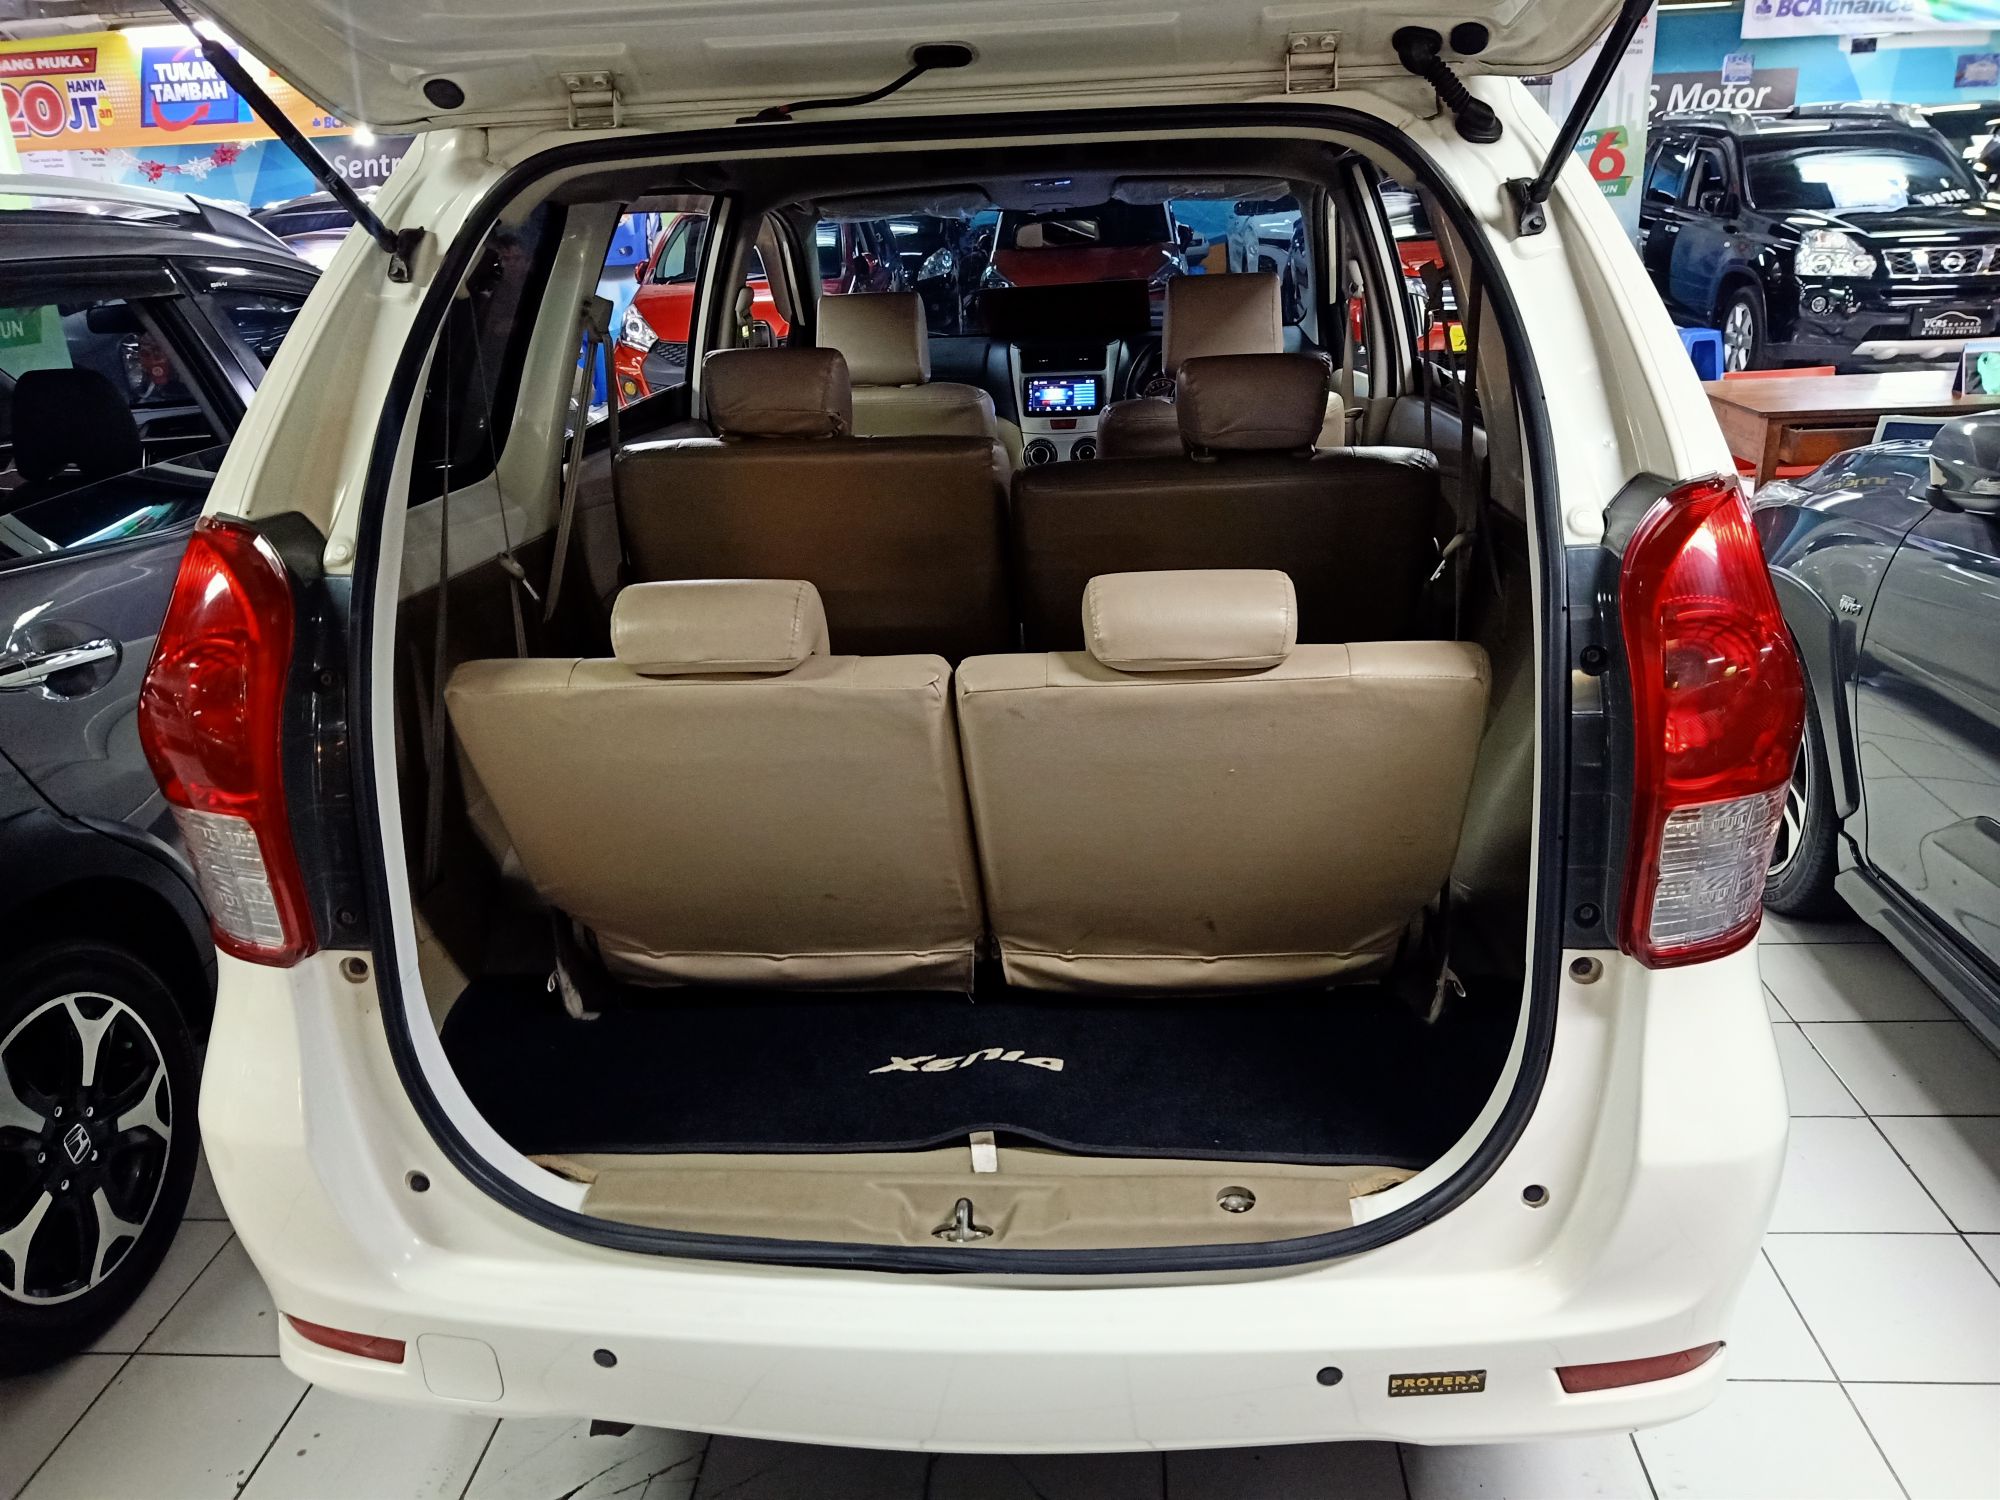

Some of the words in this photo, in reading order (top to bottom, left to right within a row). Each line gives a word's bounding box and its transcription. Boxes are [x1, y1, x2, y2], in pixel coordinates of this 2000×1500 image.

[36, 54, 84, 69] MUKA
[153, 60, 218, 82] TUKAR
[66, 79, 106, 92] HANYA
[150, 80, 229, 102] TAMBAH
[1666, 82, 1772, 112] Motor
[1589, 130, 1626, 181] 6
[1391, 1375, 1480, 1388] PROTERA
